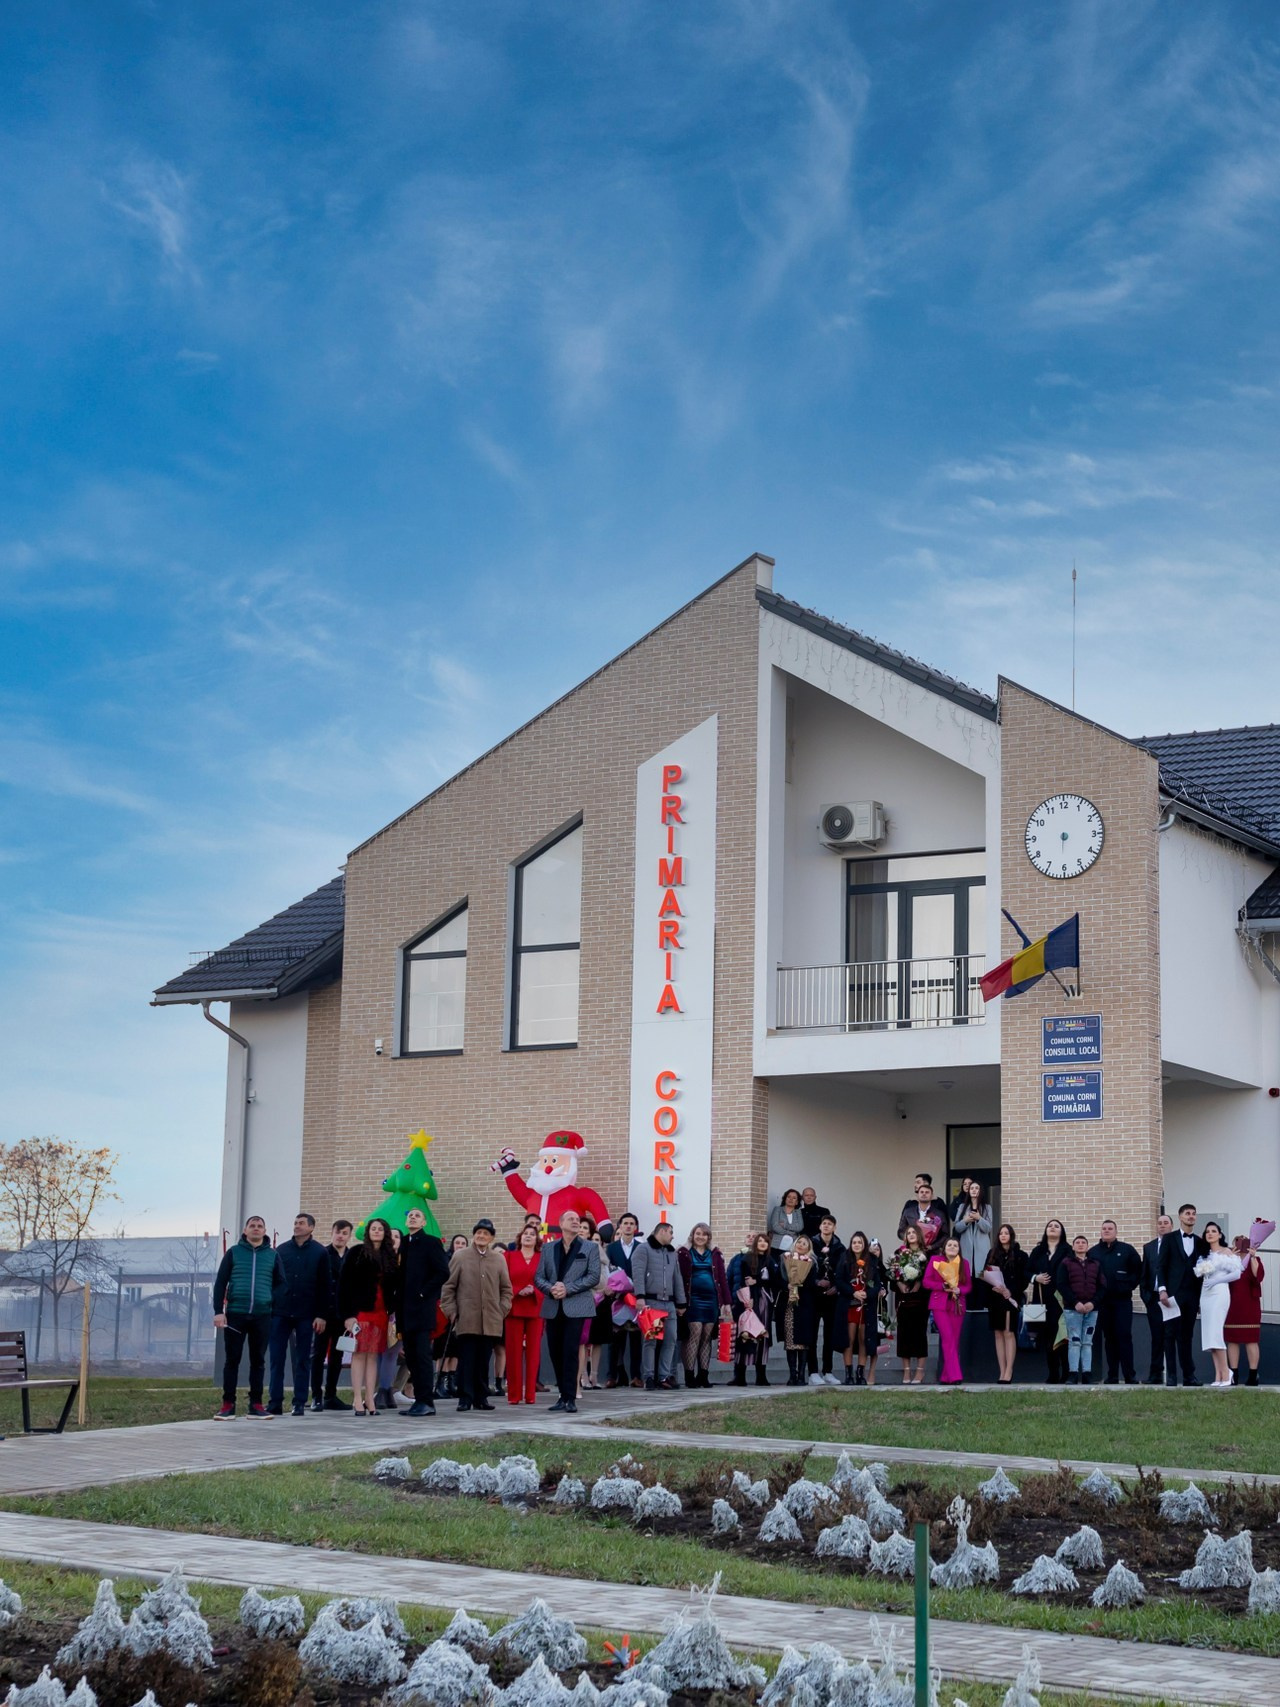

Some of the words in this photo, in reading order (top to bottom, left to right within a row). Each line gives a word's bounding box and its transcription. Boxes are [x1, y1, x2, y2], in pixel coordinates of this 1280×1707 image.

[1059, 801, 1068, 809] 12
[1062, 864, 1067, 872] 6
[656, 764, 684, 1014] PRIMARIA
[1045, 1048, 1076, 1056] CONSILIUL
[1079, 1046, 1099, 1054] LOCAL
[1053, 1103, 1091, 1114] PRIMĂRIA
